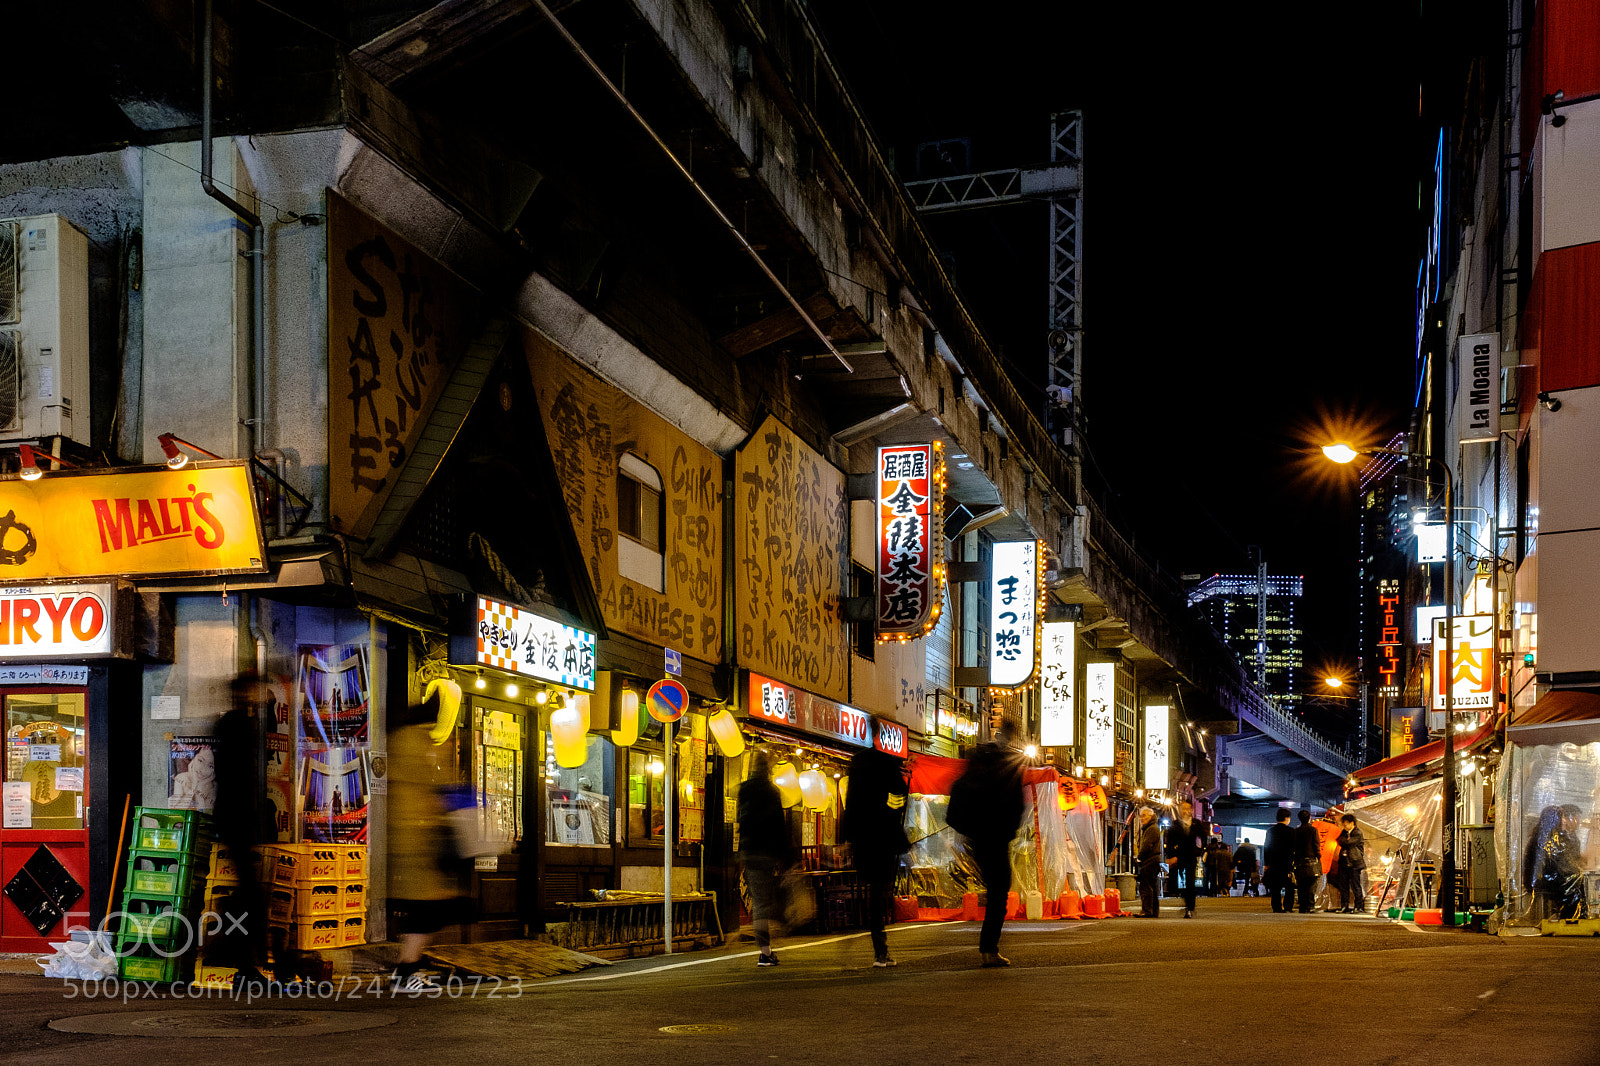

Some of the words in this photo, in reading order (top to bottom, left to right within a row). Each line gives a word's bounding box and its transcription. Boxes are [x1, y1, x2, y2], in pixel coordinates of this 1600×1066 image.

[345, 236, 396, 493] SAKE
[1470, 344, 1490, 405] Moana
[1470, 409, 1490, 429] La
[881, 454, 924, 480] 居酒屋
[92, 484, 225, 554] MALT'S
[883, 482, 926, 621] 金陵本店
[480, 620, 517, 651] やきとり
[996, 576, 1020, 661] まつ惣
[1379, 595, 1399, 686] TORAJI
[1438, 642, 1492, 696] 肉
[761, 684, 797, 724] 居酒屋
[812, 700, 867, 742] KINRYO
[312, 864, 333, 875] ホッピー
[312, 898, 334, 910] ホッピー
[313, 934, 335, 945] ホッピー
